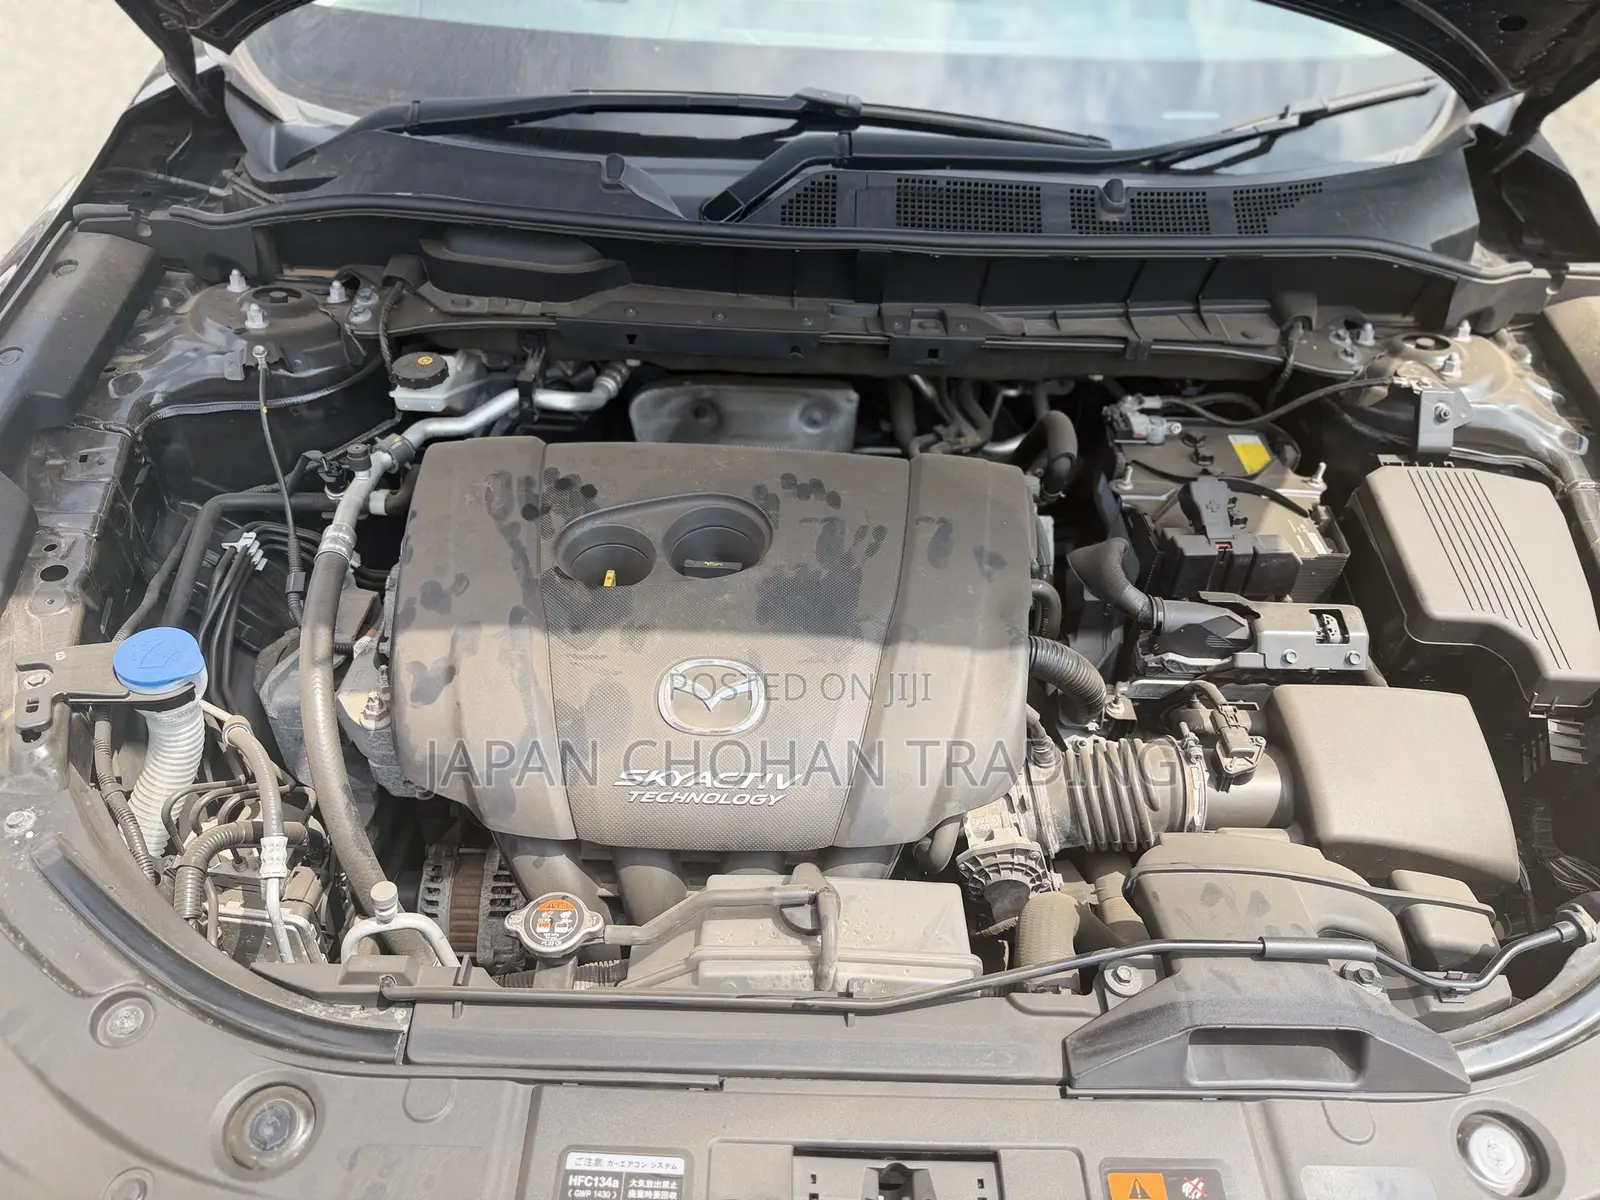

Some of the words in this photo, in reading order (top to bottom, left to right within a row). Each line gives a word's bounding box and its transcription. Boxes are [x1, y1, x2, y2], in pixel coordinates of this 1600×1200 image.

[613, 769, 804, 790] SKYACTIV
[628, 791, 787, 806] TECHNOLOGY
[568, 1175, 620, 1188] HFC134a
